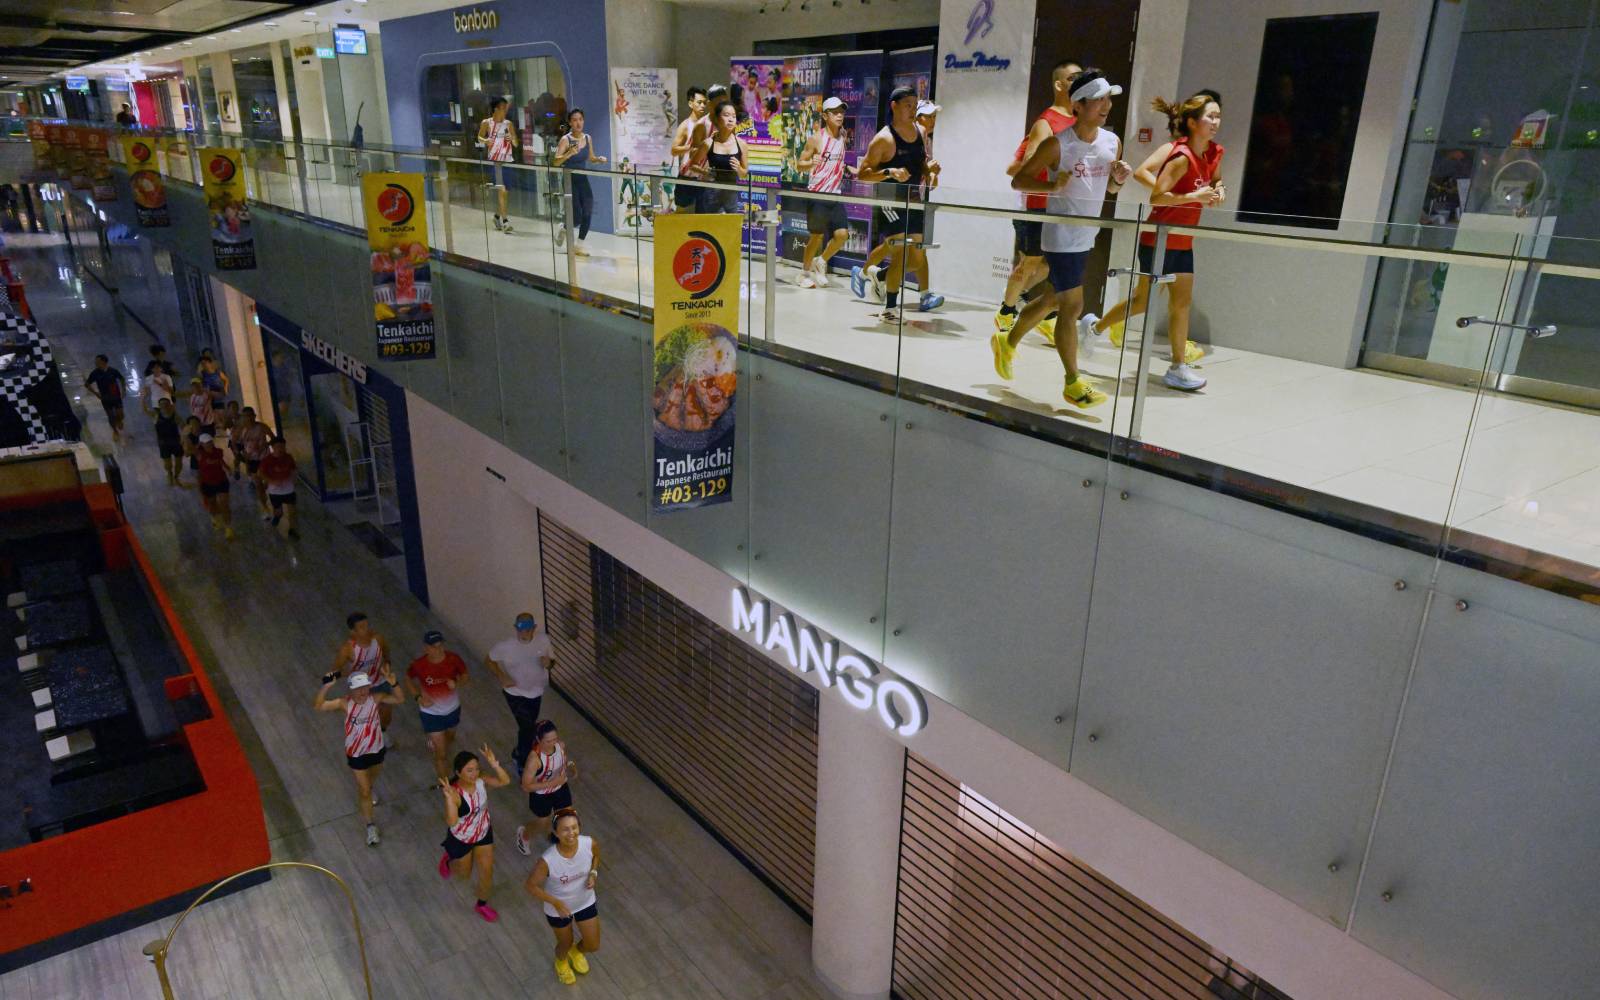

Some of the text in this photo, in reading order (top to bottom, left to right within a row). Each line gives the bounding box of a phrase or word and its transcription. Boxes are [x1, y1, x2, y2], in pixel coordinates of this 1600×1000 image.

[453, 8, 496, 33] bonbon
[831, 78, 853, 88] DANCE
[671, 299, 724, 311] TENKAICHI
[377, 321, 434, 338] Tenkaichi
[301, 328, 367, 385] SKECHERS
[383, 341, 431, 356] #03-129
[656, 446, 732, 477] Tenkaichi
[656, 466, 732, 488] Japanese Restaurant
[660, 477, 727, 504] #03-129
[732, 586, 924, 737] MANGO
